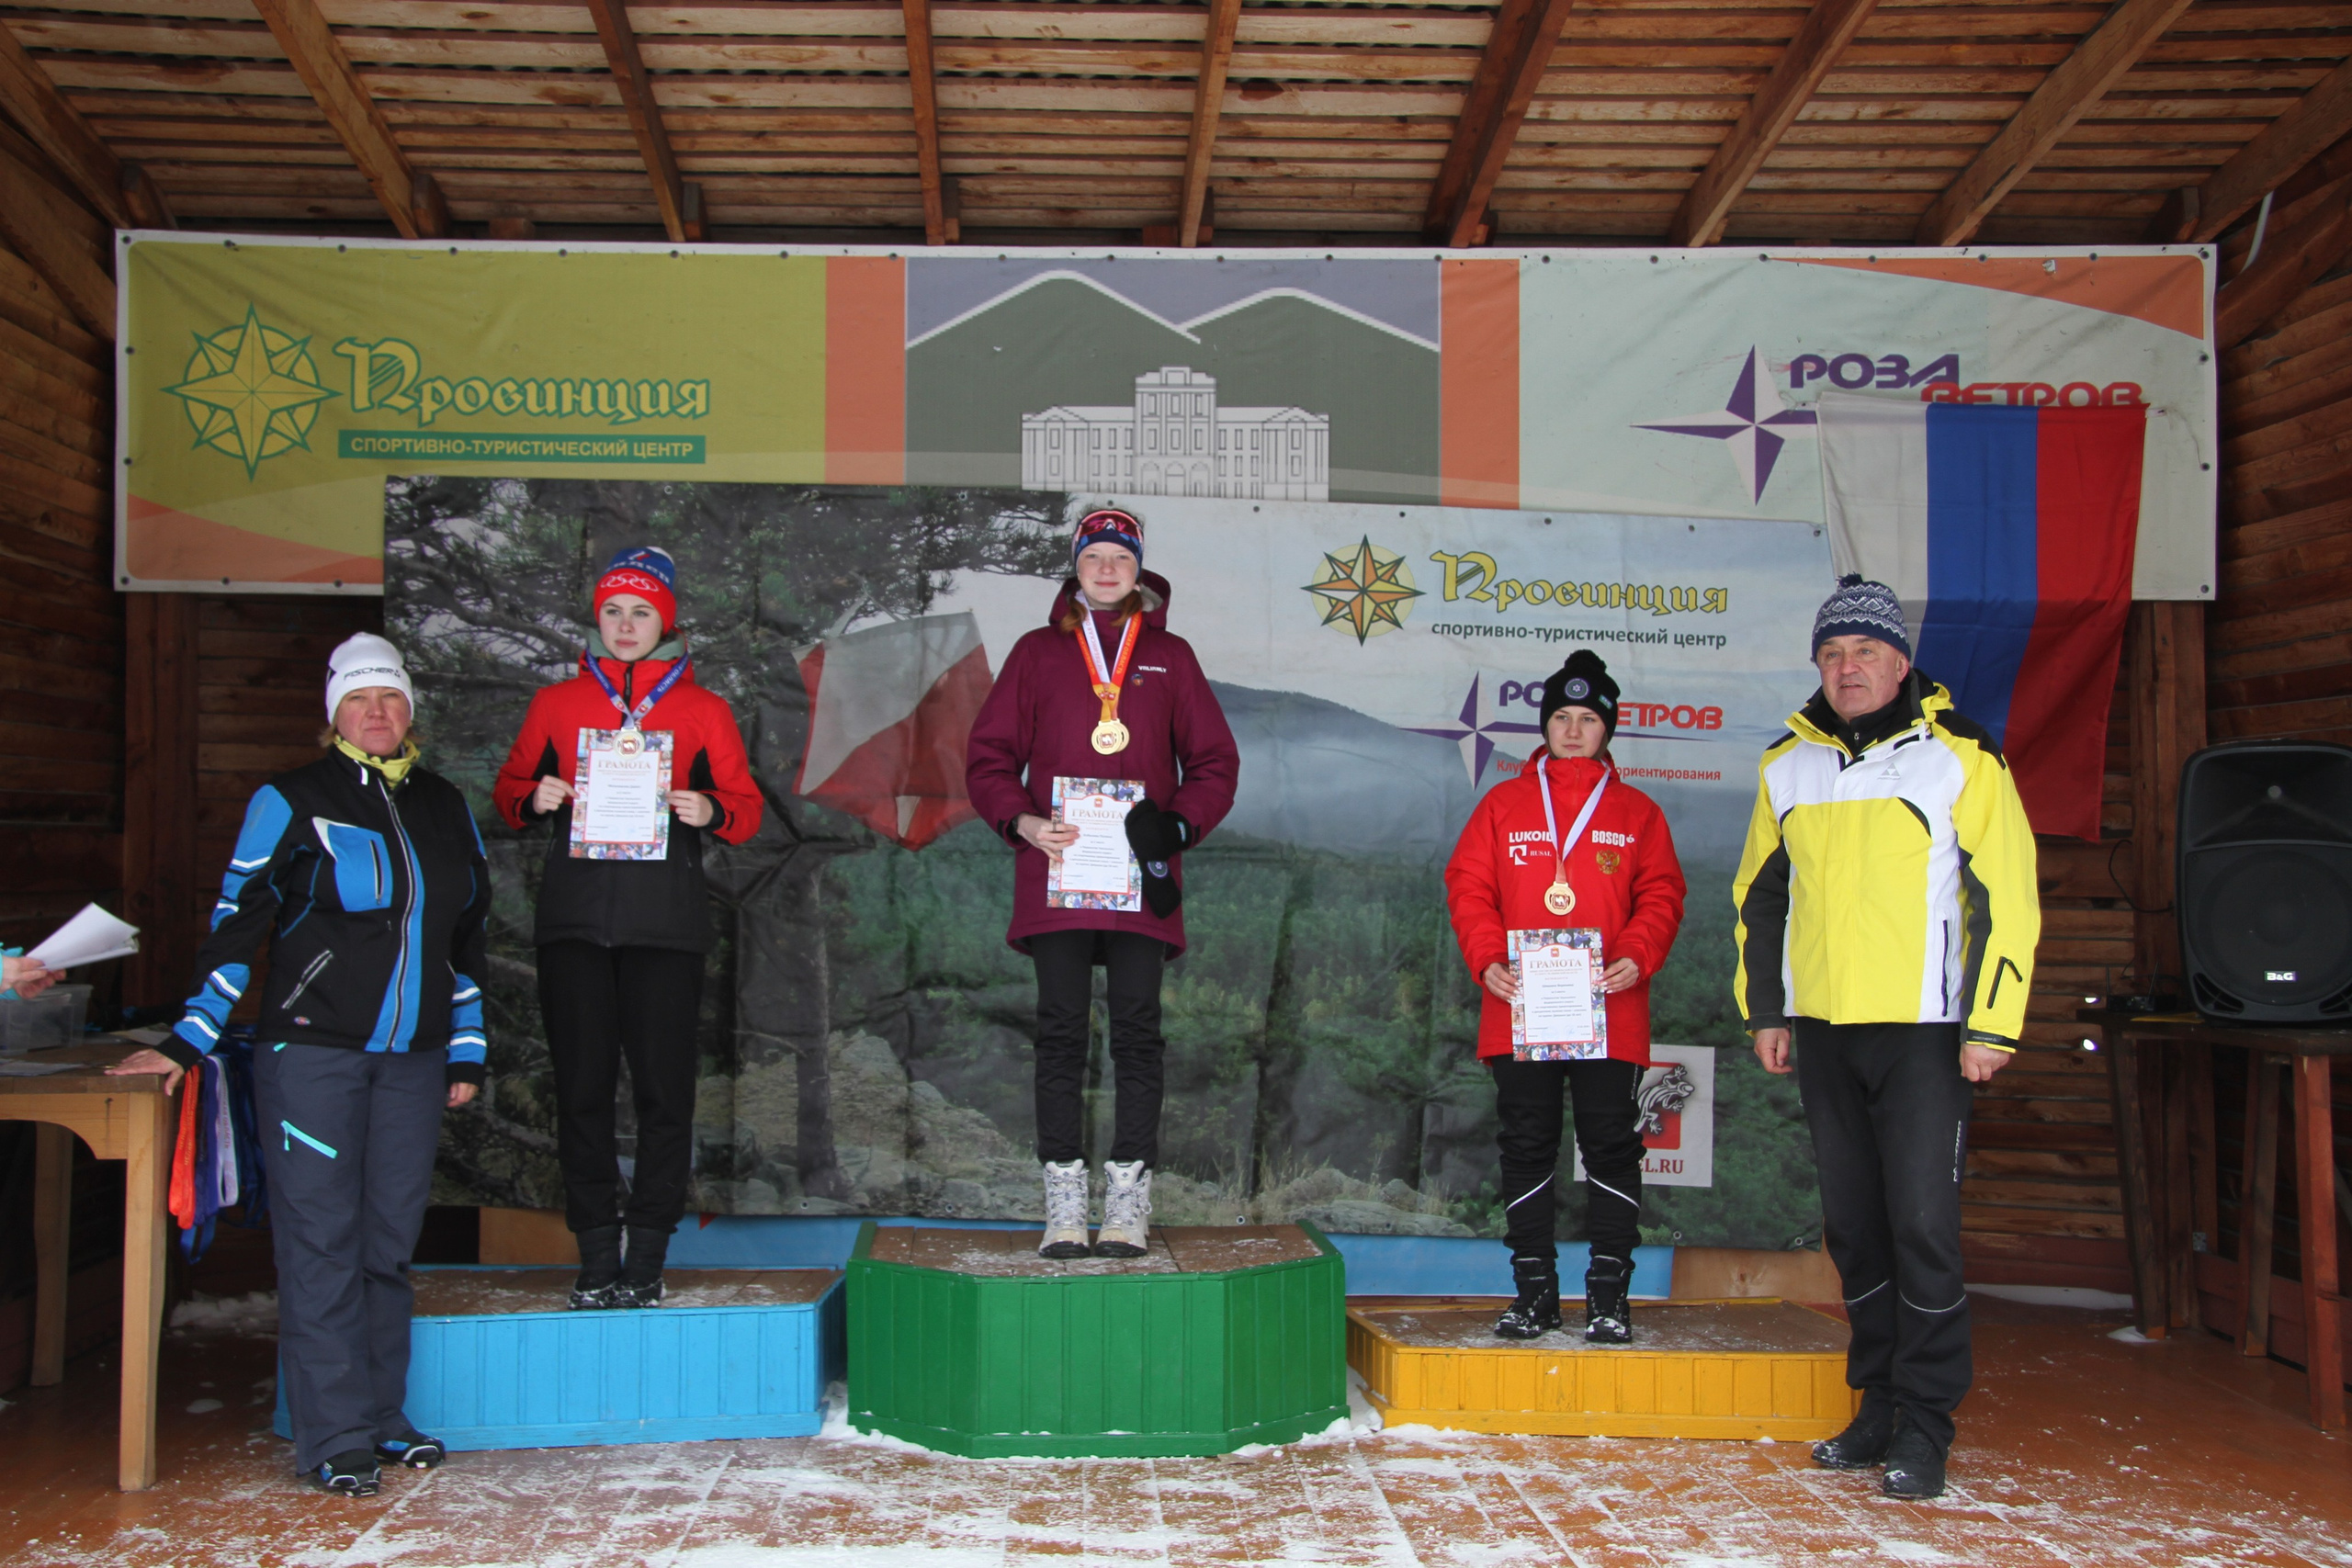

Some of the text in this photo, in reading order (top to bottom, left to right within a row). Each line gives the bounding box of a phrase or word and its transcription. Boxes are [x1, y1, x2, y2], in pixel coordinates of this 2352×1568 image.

[1790, 353, 1960, 389] РОЗА
[332, 336, 710, 428] Провинция
[351, 437, 694, 458] СПОРТИВНО-ТУРИСТИЧЕСКИЙ ЦЕНТР
[1430, 550, 1727, 616] Провинция
[1431, 622, 1727, 649] спортивно-туристический центр
[1498, 680, 1545, 708] РО
[1617, 702, 1724, 730] ЕТРОВ
[598, 760, 651, 770] ГРАМОТА
[1615, 766, 1721, 782] ориентирования
[1071, 808, 1125, 819] ГРАМОТА
[1509, 830, 1553, 843] LUKOIL
[1591, 829, 1625, 848] BOSCO
[1529, 958, 1583, 969] ГРАМОТА
[2267, 972, 2294, 981] B&G
